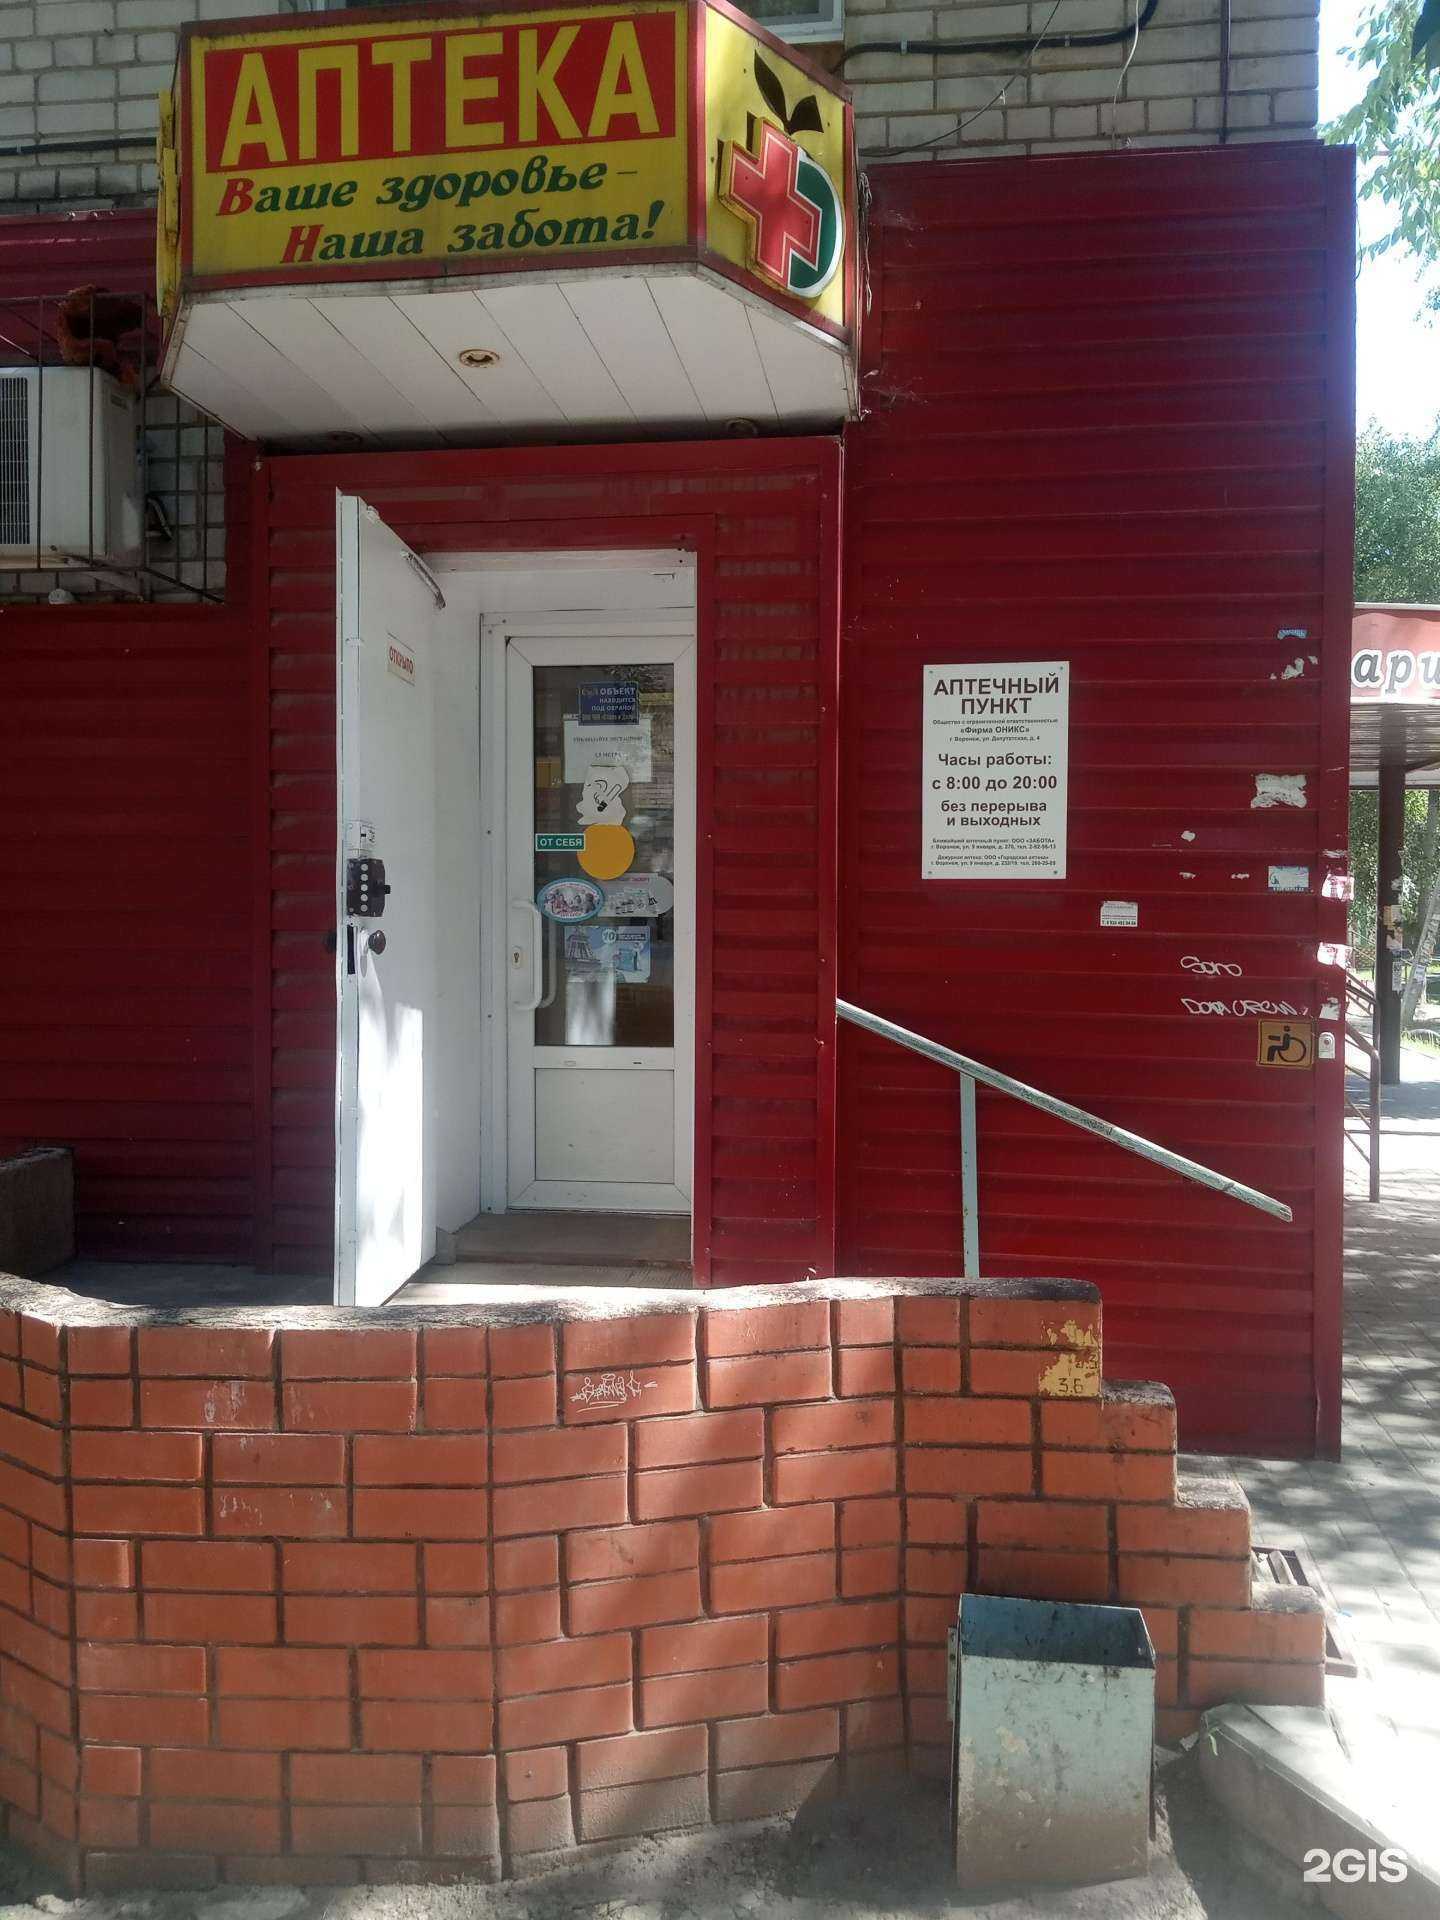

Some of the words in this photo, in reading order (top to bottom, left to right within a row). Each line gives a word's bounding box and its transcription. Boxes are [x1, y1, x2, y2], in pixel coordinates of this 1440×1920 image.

[219, 20, 662, 167] АПТЕКА
[215, 177, 357, 217] Ваше
[375, 153, 607, 212] здоровье
[279, 222, 425, 265] Наша
[446, 200, 667, 253] забота!
[600, 687, 636, 695] ОБЪЕКТ
[933, 672, 1059, 696] АПТЕЧНЫЙ
[606, 703, 636, 711] ОХРАНОЙ
[961, 697, 1032, 714] ПУНКТ
[960, 726, 993, 735] «Фирма
[995, 725, 1030, 734] ОНИКС»
[938, 753, 981, 766] Часы
[986, 752, 1052, 768] работы:
[932, 779, 941, 789] с
[946, 776, 981, 789] 8:00
[985, 779, 1007, 791] до
[1012, 775, 1057, 789] 20:00
[941, 800, 966, 812] без
[971, 802, 1047, 814] перерыва
[946, 817, 956, 826] и
[960, 816, 1041, 828] выходных
[540, 838, 553, 846] ОТ
[555, 838, 583, 847] СЕБЯ
